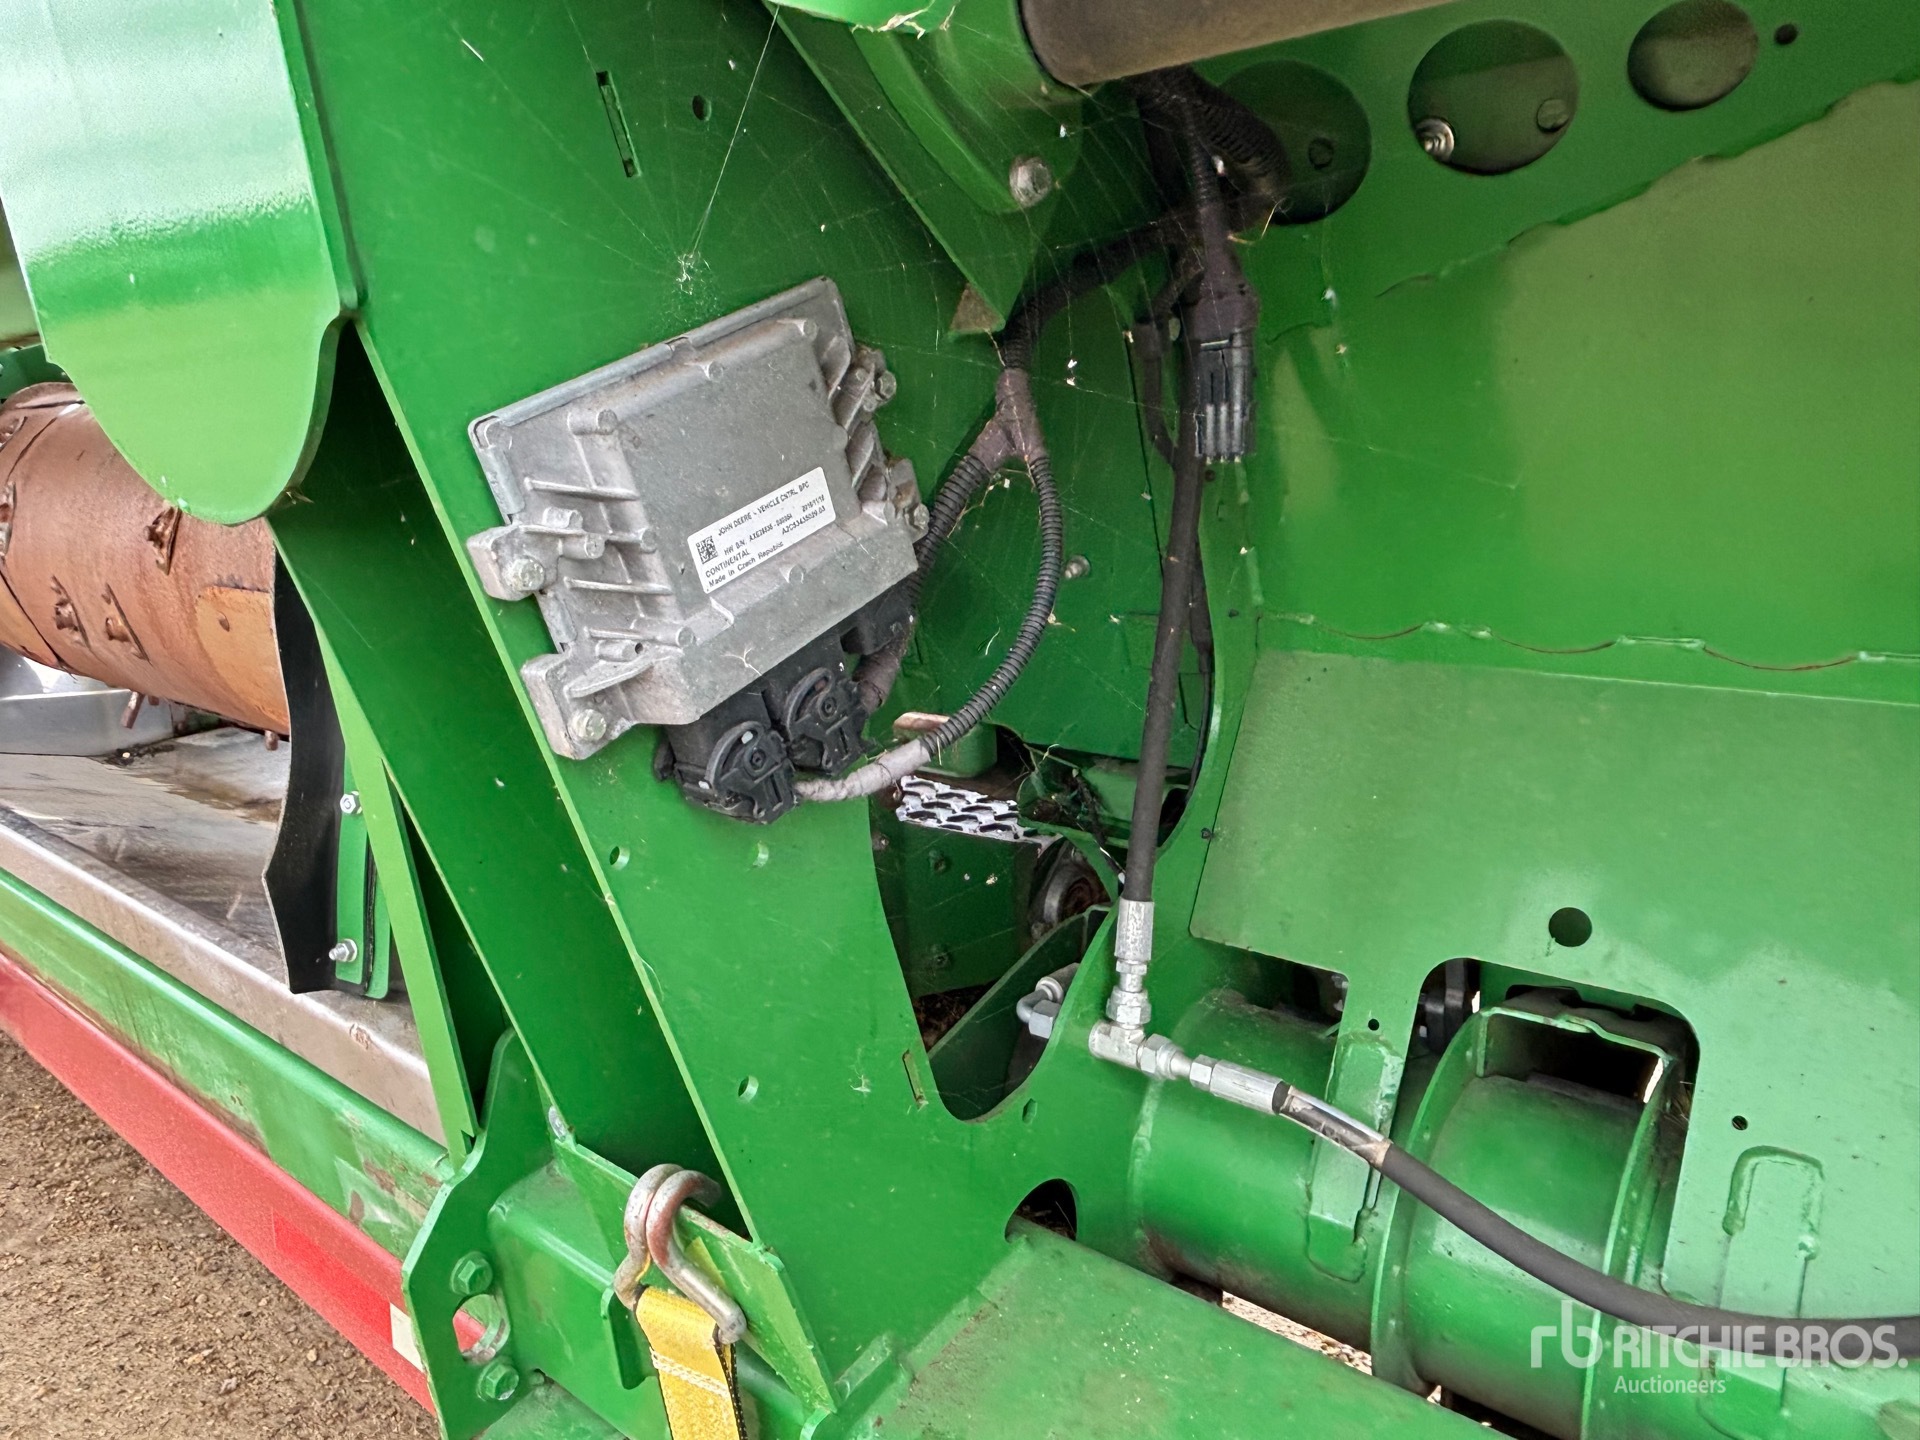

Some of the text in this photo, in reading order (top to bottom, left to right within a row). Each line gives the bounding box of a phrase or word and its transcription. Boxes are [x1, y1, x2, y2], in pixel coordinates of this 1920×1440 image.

[718, 523, 734, 536] JOHN
[734, 512, 752, 528] DEERE
[757, 497, 780, 514] VEHICLE
[705, 549, 750, 578] CONTINENTAL
[708, 541, 784, 588] Made in Czech Republic
[724, 545, 734, 556] HW
